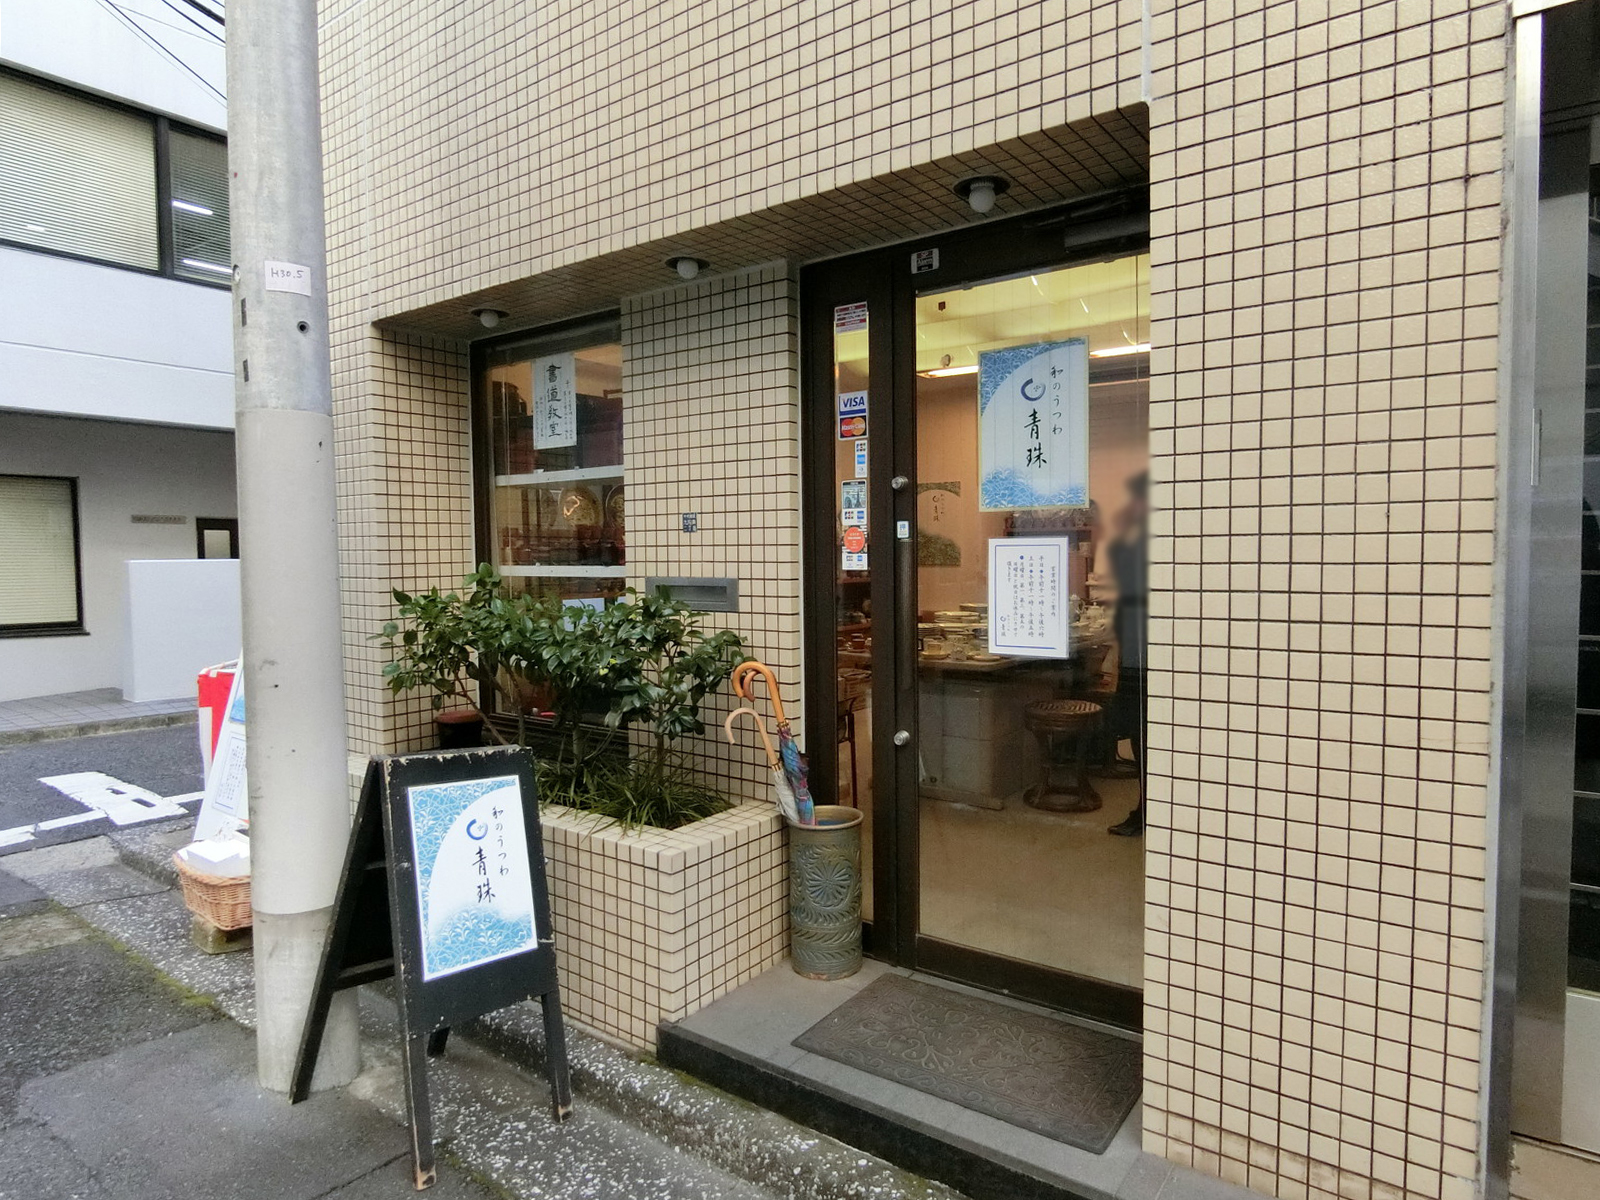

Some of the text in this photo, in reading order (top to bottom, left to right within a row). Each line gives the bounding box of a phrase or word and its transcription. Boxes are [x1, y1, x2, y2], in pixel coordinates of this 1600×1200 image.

[270, 267, 304, 279] H30.5
[546, 362, 562, 438] 書道教室
[843, 396, 865, 408] VISA
[1050, 365, 1064, 436] 和のうつわ
[1024, 407, 1048, 469] 青珠
[492, 805, 509, 876] 和のうつわ
[472, 846, 496, 904] 青珠
